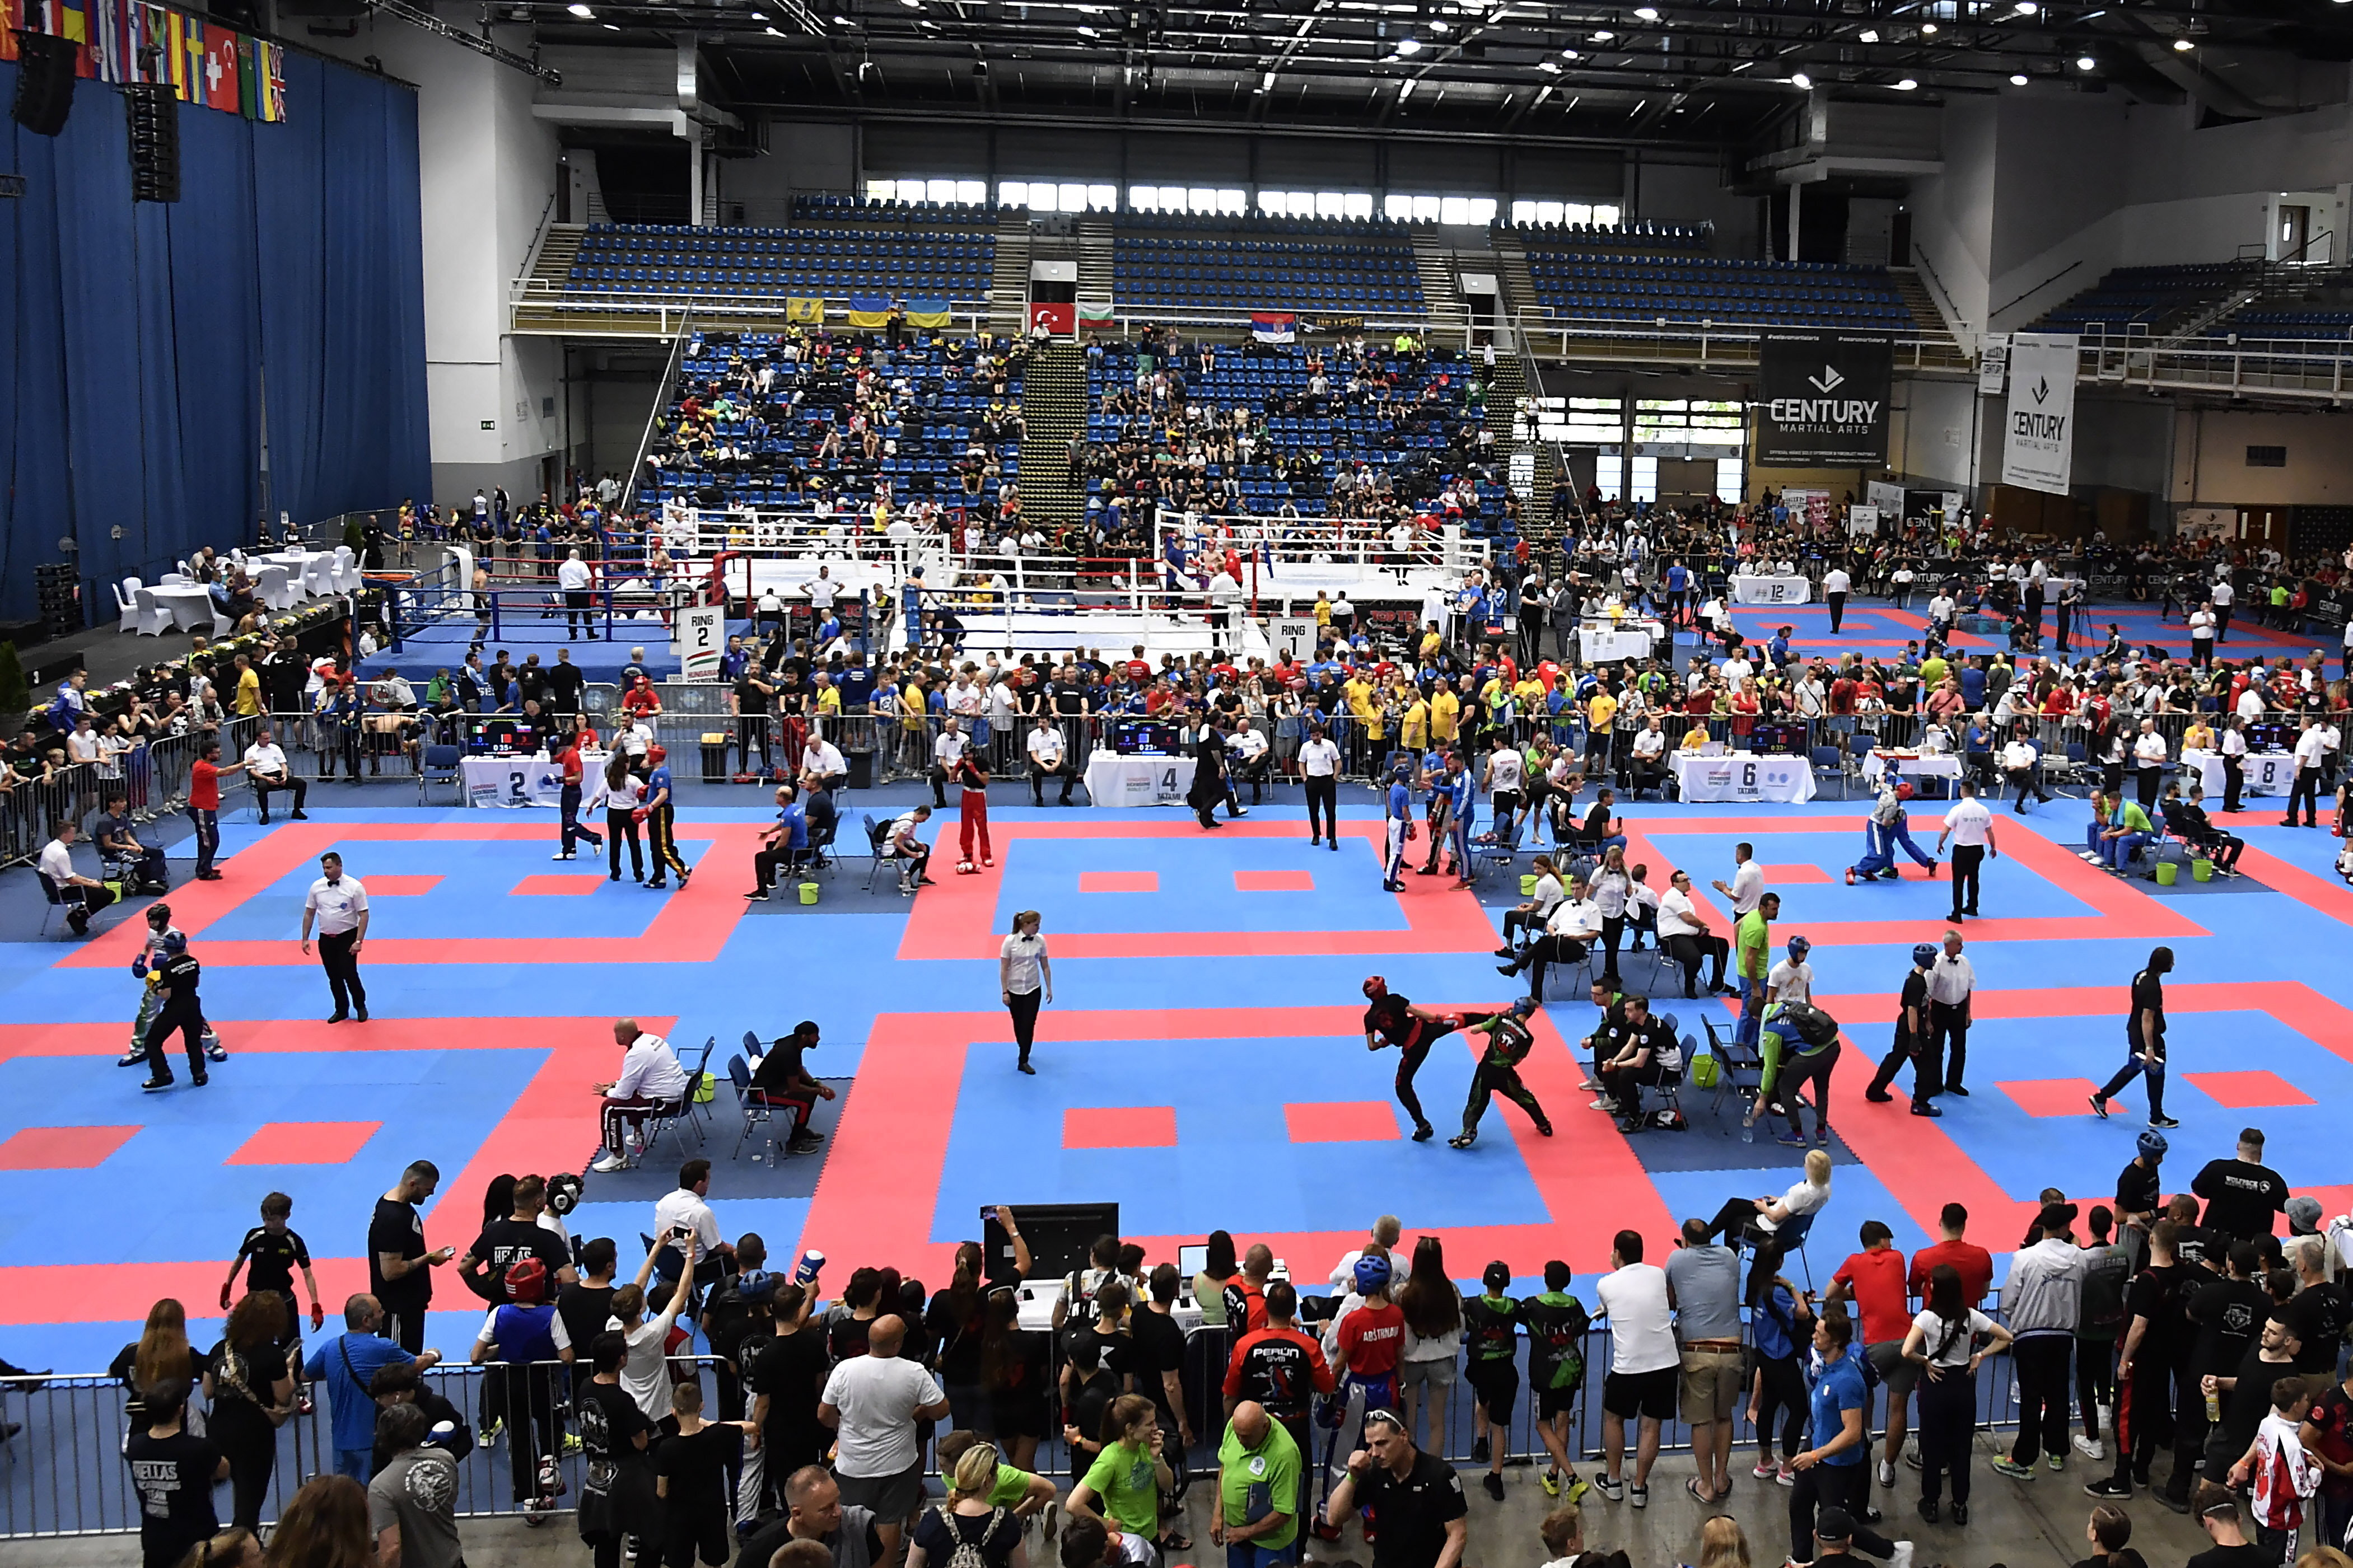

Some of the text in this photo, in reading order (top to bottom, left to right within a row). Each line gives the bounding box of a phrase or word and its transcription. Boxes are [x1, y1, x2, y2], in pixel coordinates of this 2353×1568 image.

[1771, 399, 1879, 423] CENTURY
[1780, 424, 1869, 434] MARTIAL ARTS
[2013, 411, 2065, 441] CENTURY
[1771, 584, 1785, 598] 12
[692, 615, 713, 626] RING
[1370, 610, 1416, 622] TOP TE
[698, 627, 708, 647] 2
[1281, 625, 1306, 636] RING
[1290, 637, 1297, 656] 1
[1162, 767, 1178, 792] 4
[1743, 763, 1756, 787] 6
[2263, 761, 2275, 784] 8
[510, 771, 525, 797] 2
